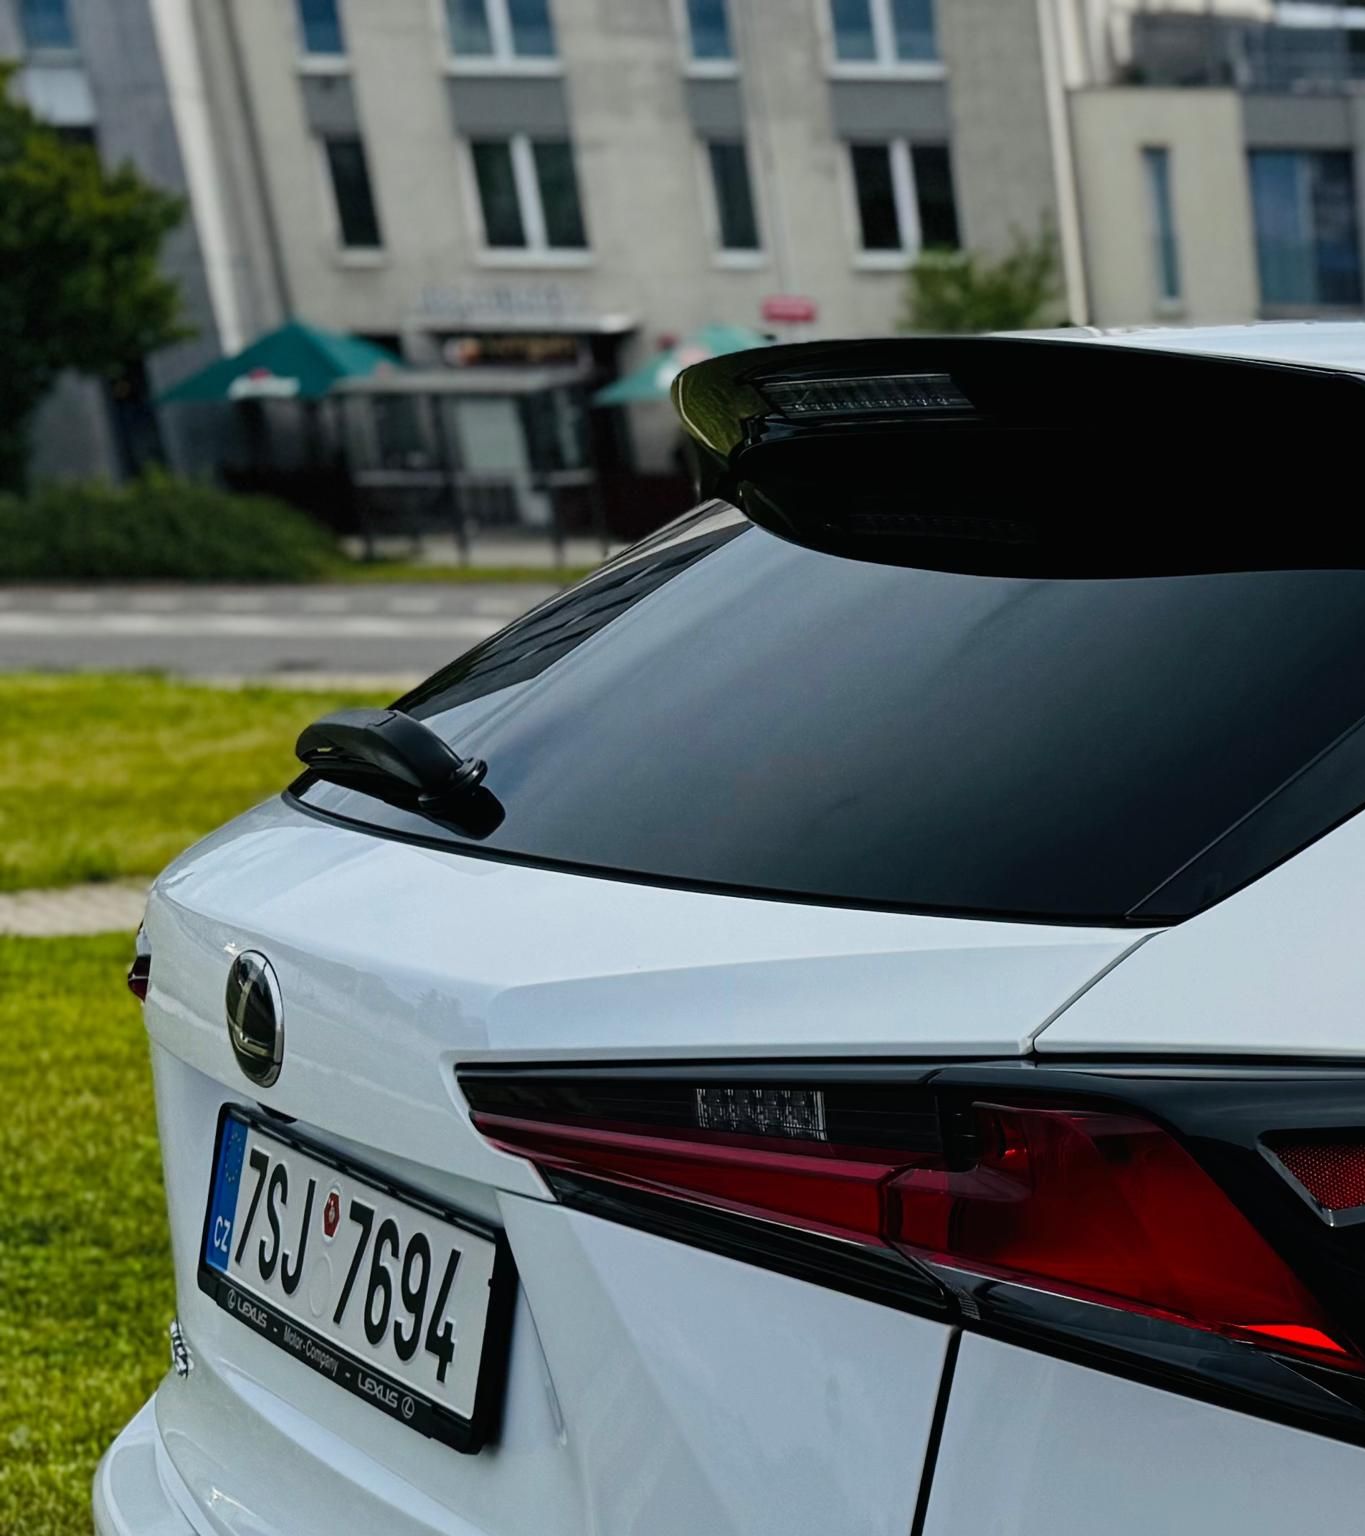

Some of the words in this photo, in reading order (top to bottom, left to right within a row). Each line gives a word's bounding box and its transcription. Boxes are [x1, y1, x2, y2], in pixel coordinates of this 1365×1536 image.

[214, 1216, 231, 1252] CZ
[234, 1147, 316, 1295] 7SJ
[334, 1199, 461, 1383] 7694
[238, 1299, 267, 1328] LEXUS
[358, 1373, 399, 1408] LEXUS
